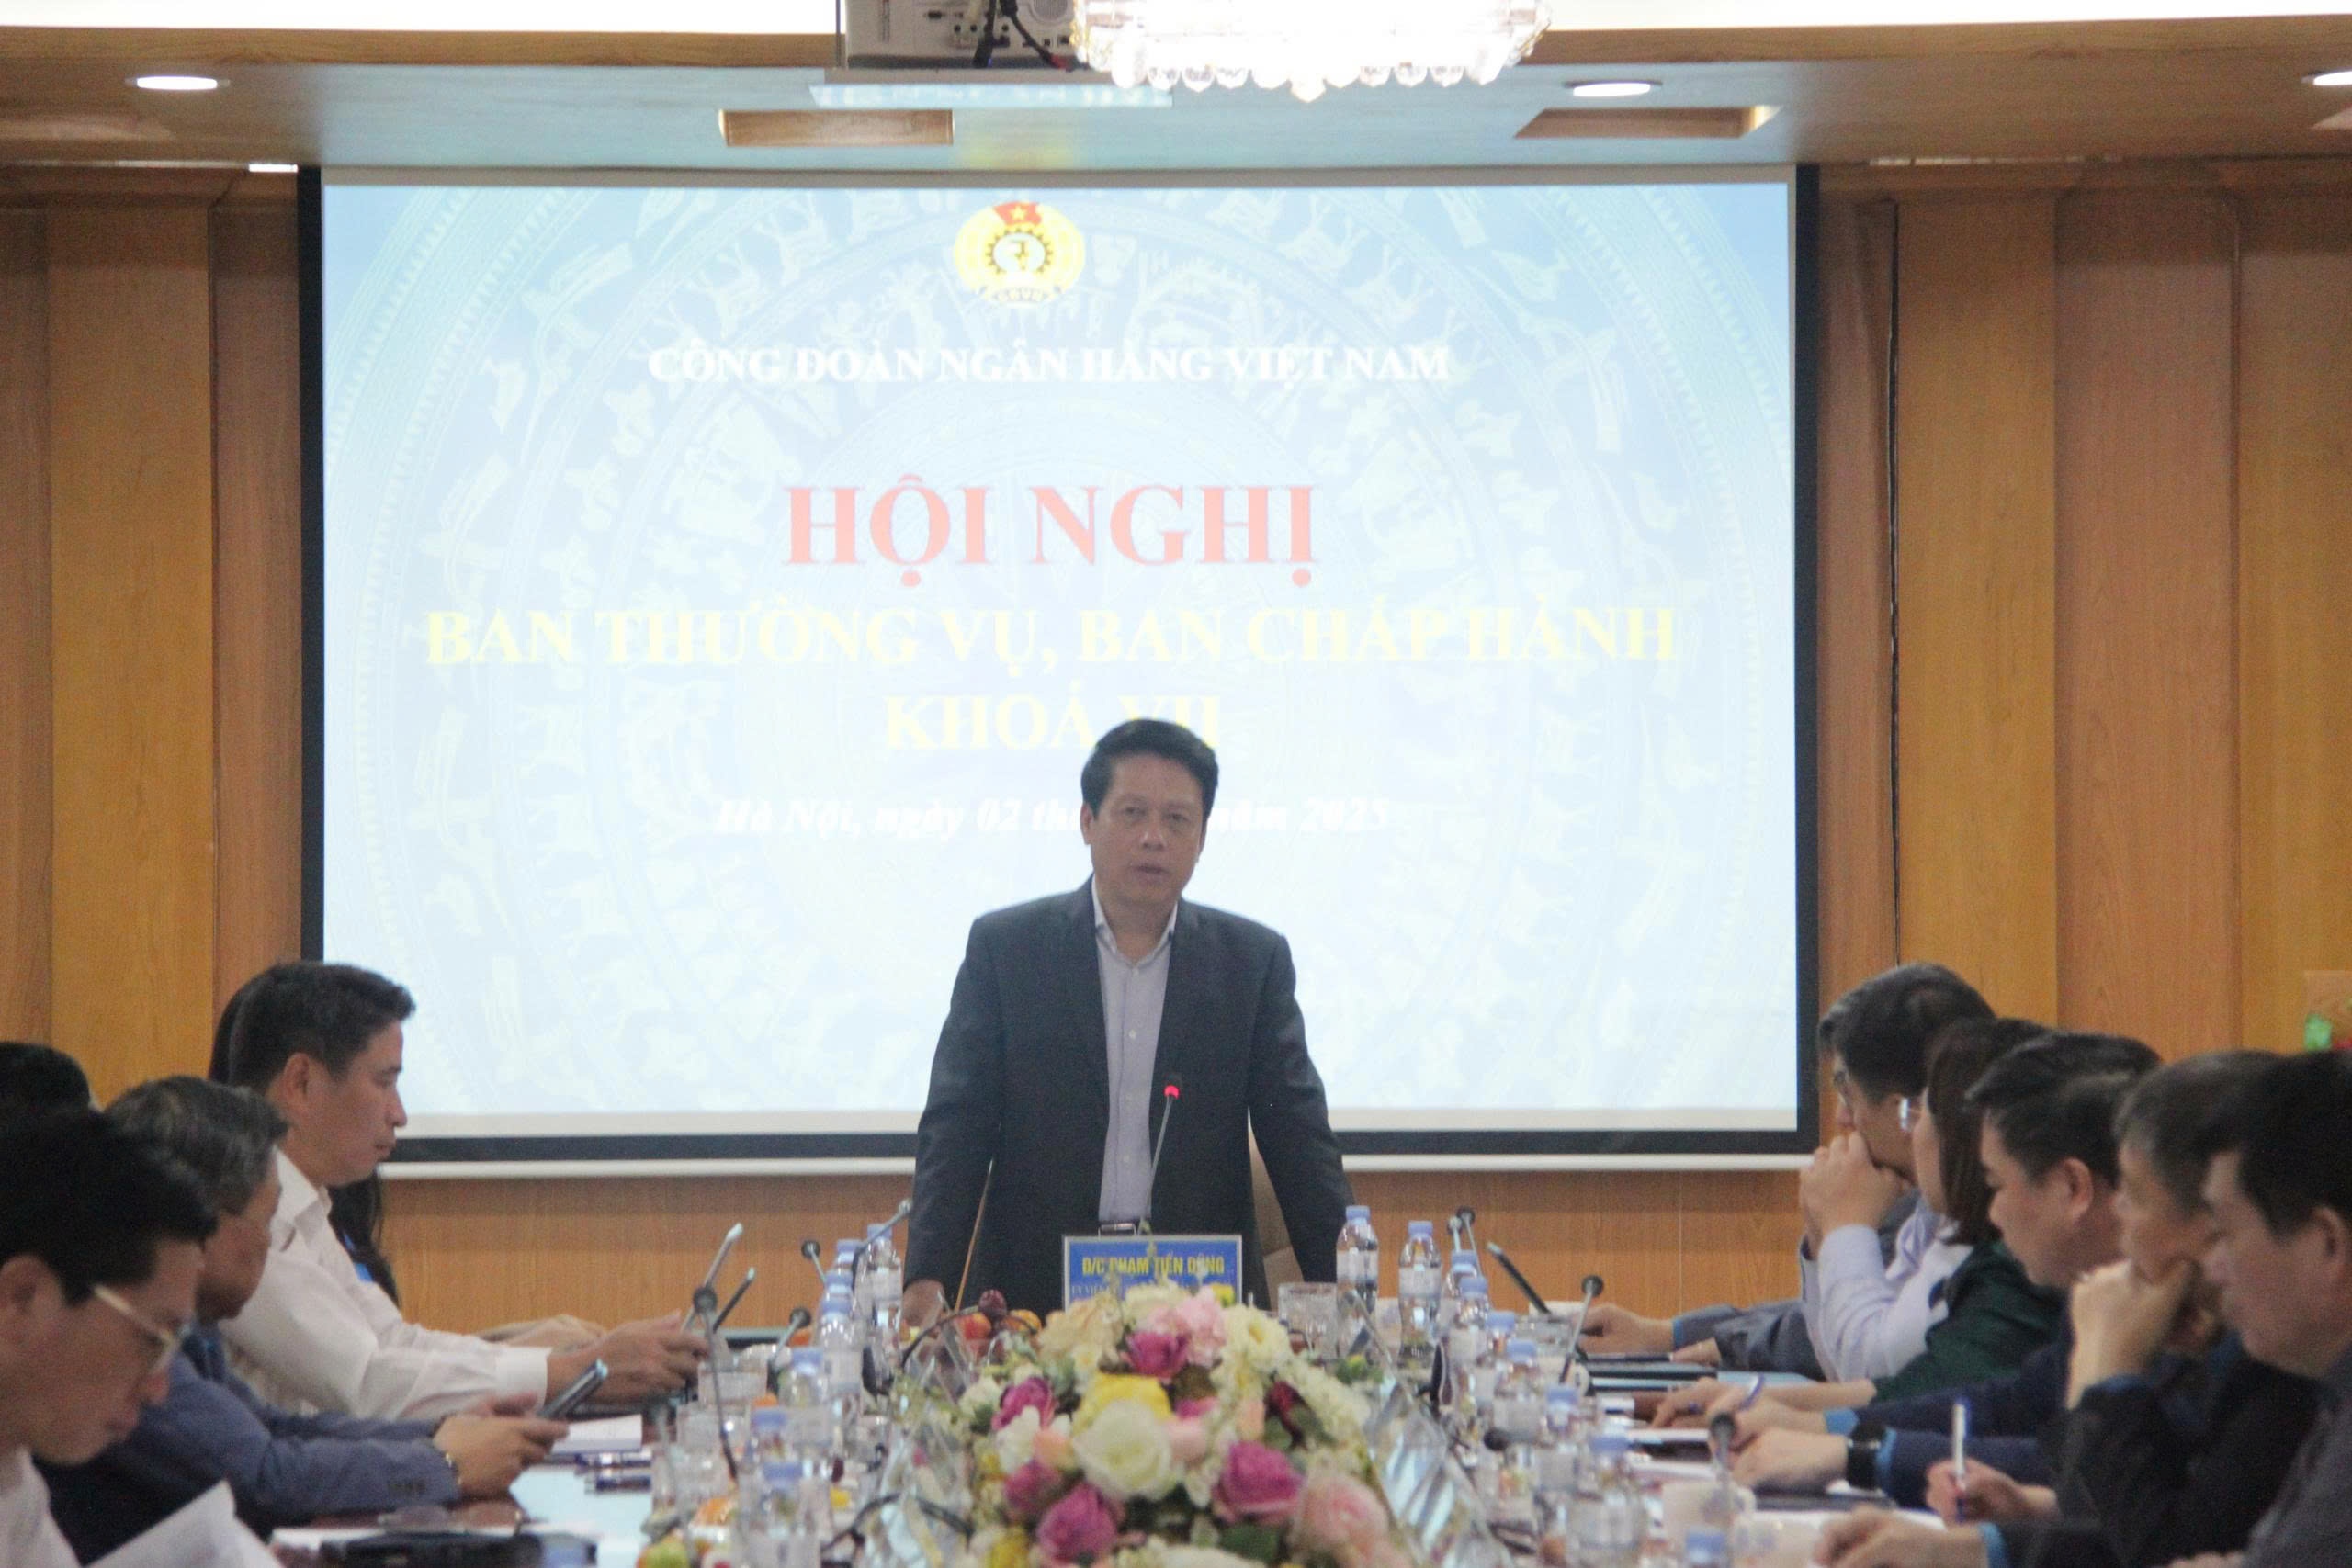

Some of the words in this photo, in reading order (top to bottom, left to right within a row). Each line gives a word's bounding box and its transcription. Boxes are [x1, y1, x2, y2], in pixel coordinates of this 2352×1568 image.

[648, 336, 783, 383] CÔNG
[938, 336, 1069, 382] NGÂN
[1345, 346, 1450, 382] NAM
[783, 473, 989, 588] HỘI
[1030, 483, 1319, 588] NGHỊ
[427, 610, 571, 663] BAN
[594, 597, 918, 664] THƯỜNG
[941, 609, 1058, 678] VỤ,
[1080, 608, 1223, 663] BAN
[1467, 593, 1678, 661] HÀNH
[883, 678, 1096, 750] KHOÁ
